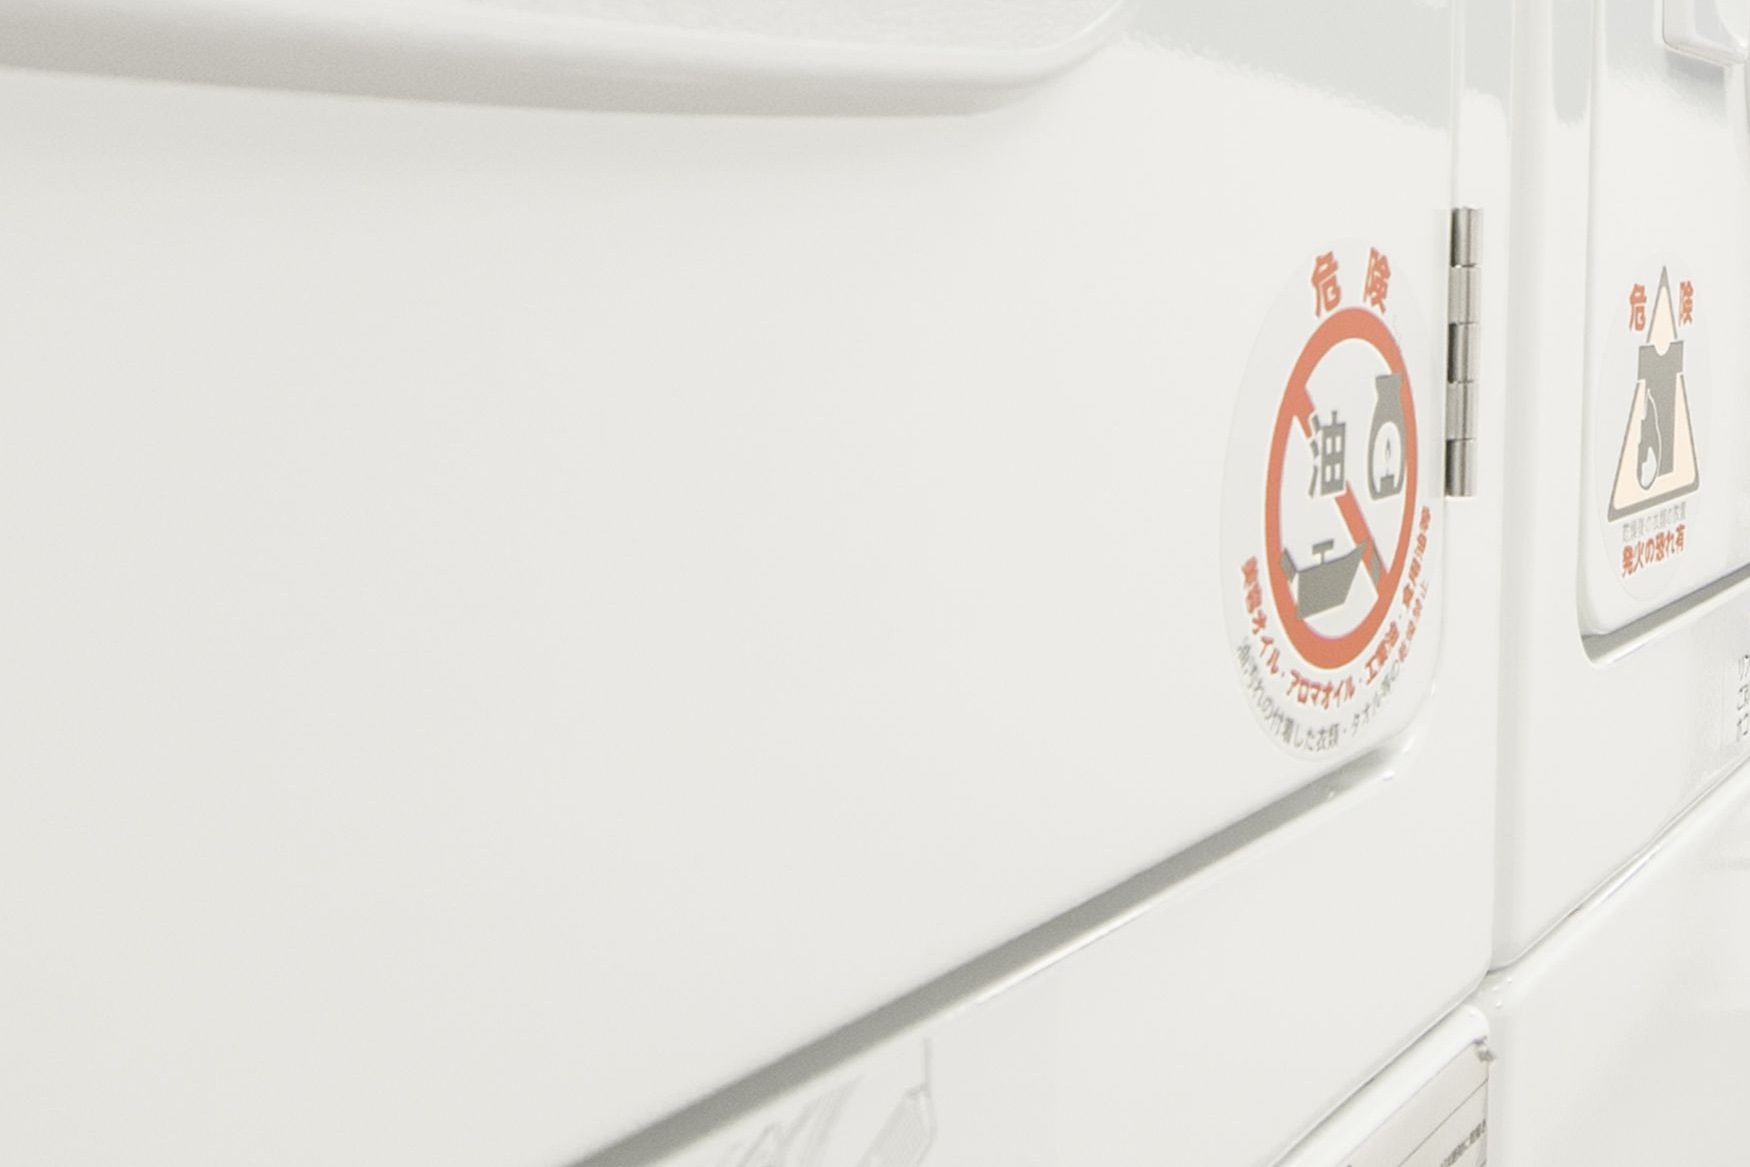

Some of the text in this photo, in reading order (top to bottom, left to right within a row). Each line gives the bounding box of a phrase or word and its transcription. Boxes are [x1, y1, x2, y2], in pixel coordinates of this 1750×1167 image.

[1310, 246, 1392, 318] 危険
[1628, 280, 1694, 332] 危険
[1307, 410, 1348, 501] 油
